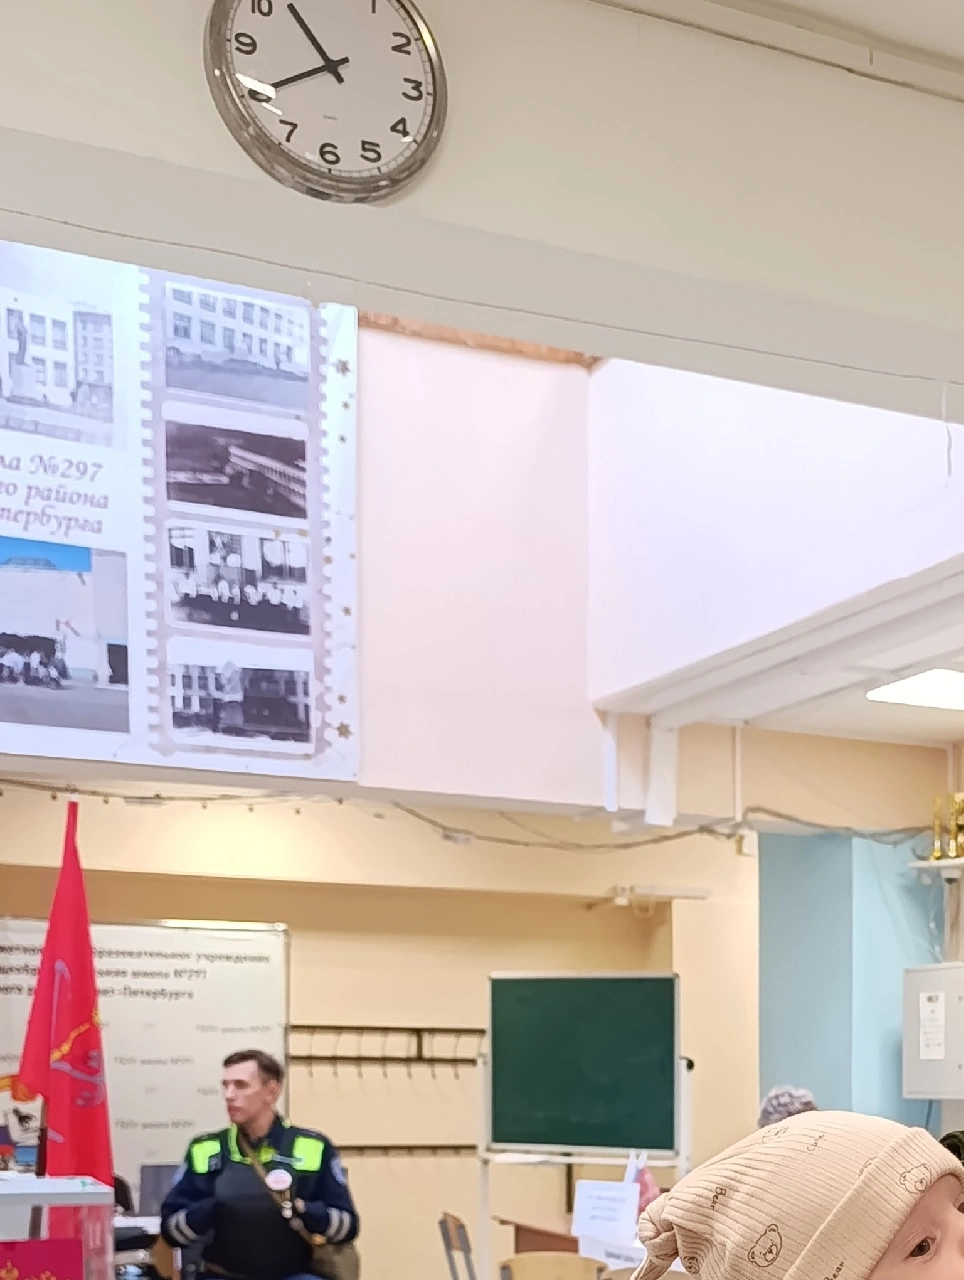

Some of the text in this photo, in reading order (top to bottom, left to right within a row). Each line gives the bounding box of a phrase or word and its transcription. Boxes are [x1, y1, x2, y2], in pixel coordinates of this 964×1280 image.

[251, 0, 274, 17] 10
[234, 33, 257, 55] 9
[391, 32, 412, 55] 2
[402, 78, 423, 101] 3
[279, 119, 298, 143] 7
[390, 117, 410, 138] 4
[319, 142, 341, 165] 6
[360, 140, 382, 163] 5
[28, 454, 103, 481] №297
[24, 483, 109, 509] района
[0, 505, 102, 538] тербурга
